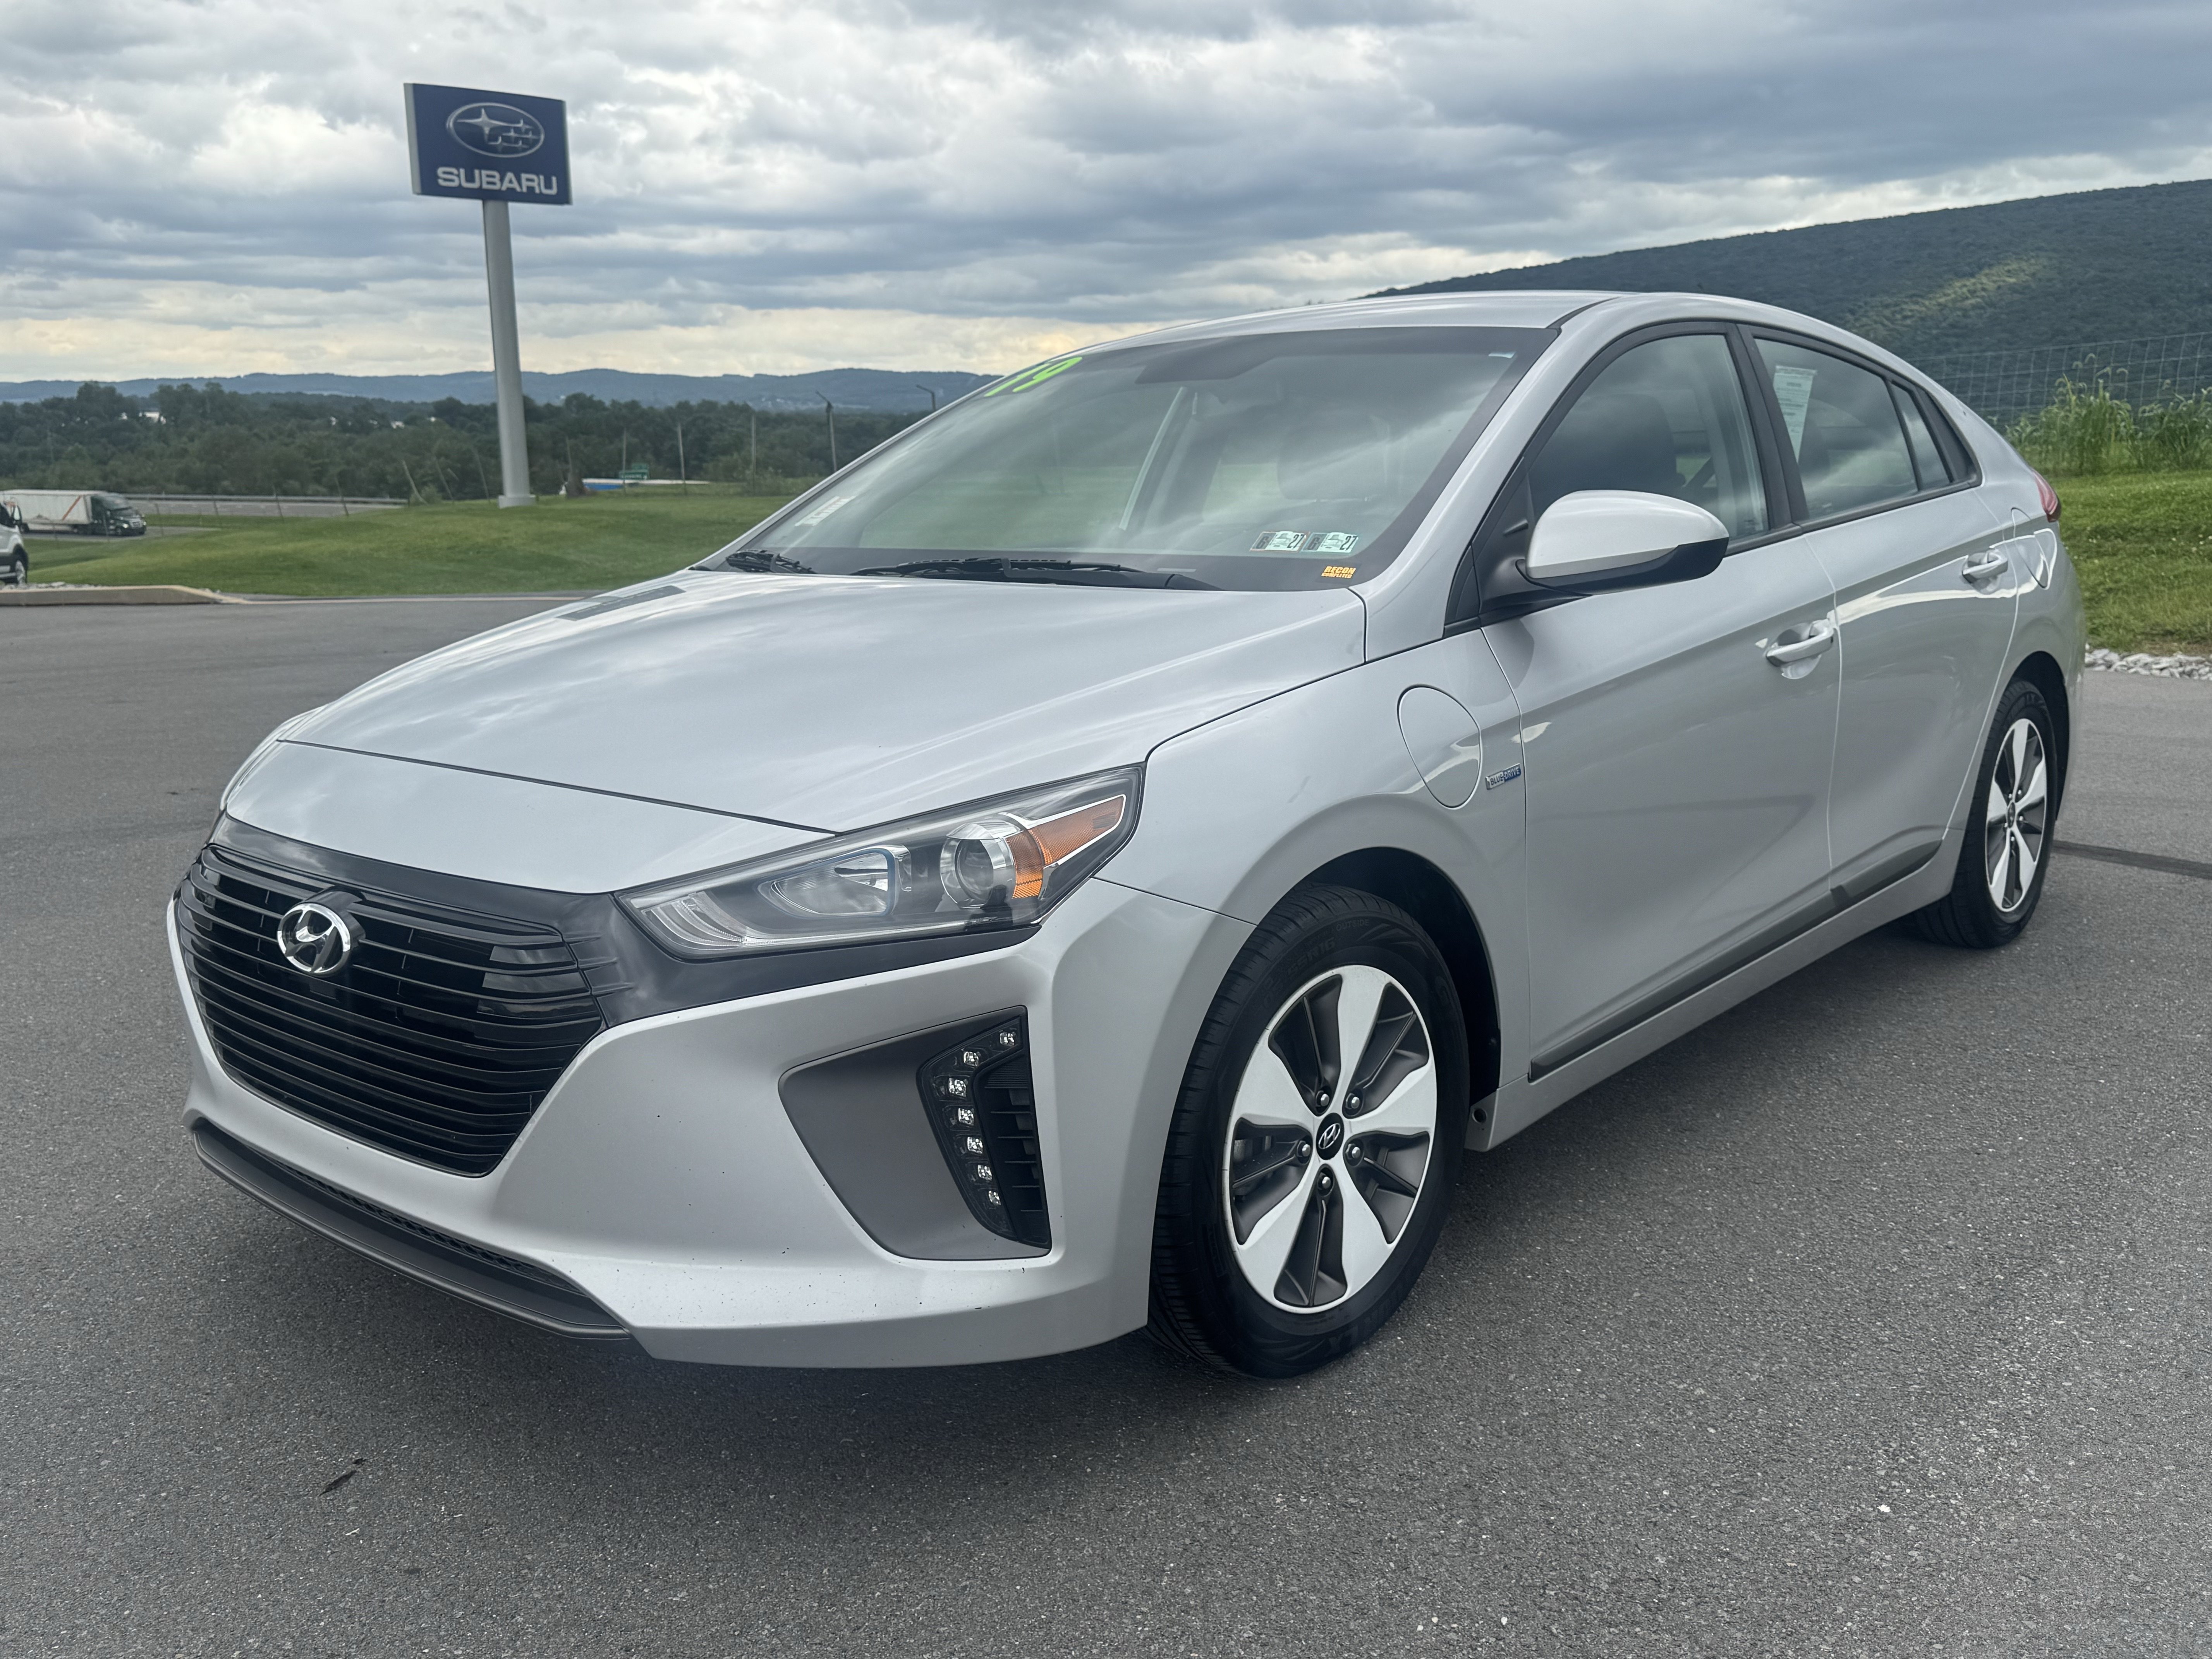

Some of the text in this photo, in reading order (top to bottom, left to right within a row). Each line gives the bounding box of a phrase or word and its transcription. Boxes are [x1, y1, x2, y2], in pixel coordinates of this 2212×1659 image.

[437, 167, 558, 196] SUBARU
[1256, 536, 1269, 549] 6
[1287, 534, 1305, 550] 27
[1339, 536, 1358, 551] 27
[1324, 566, 1356, 574] RECON
[1336, 919, 1370, 931] OUTSIDE
